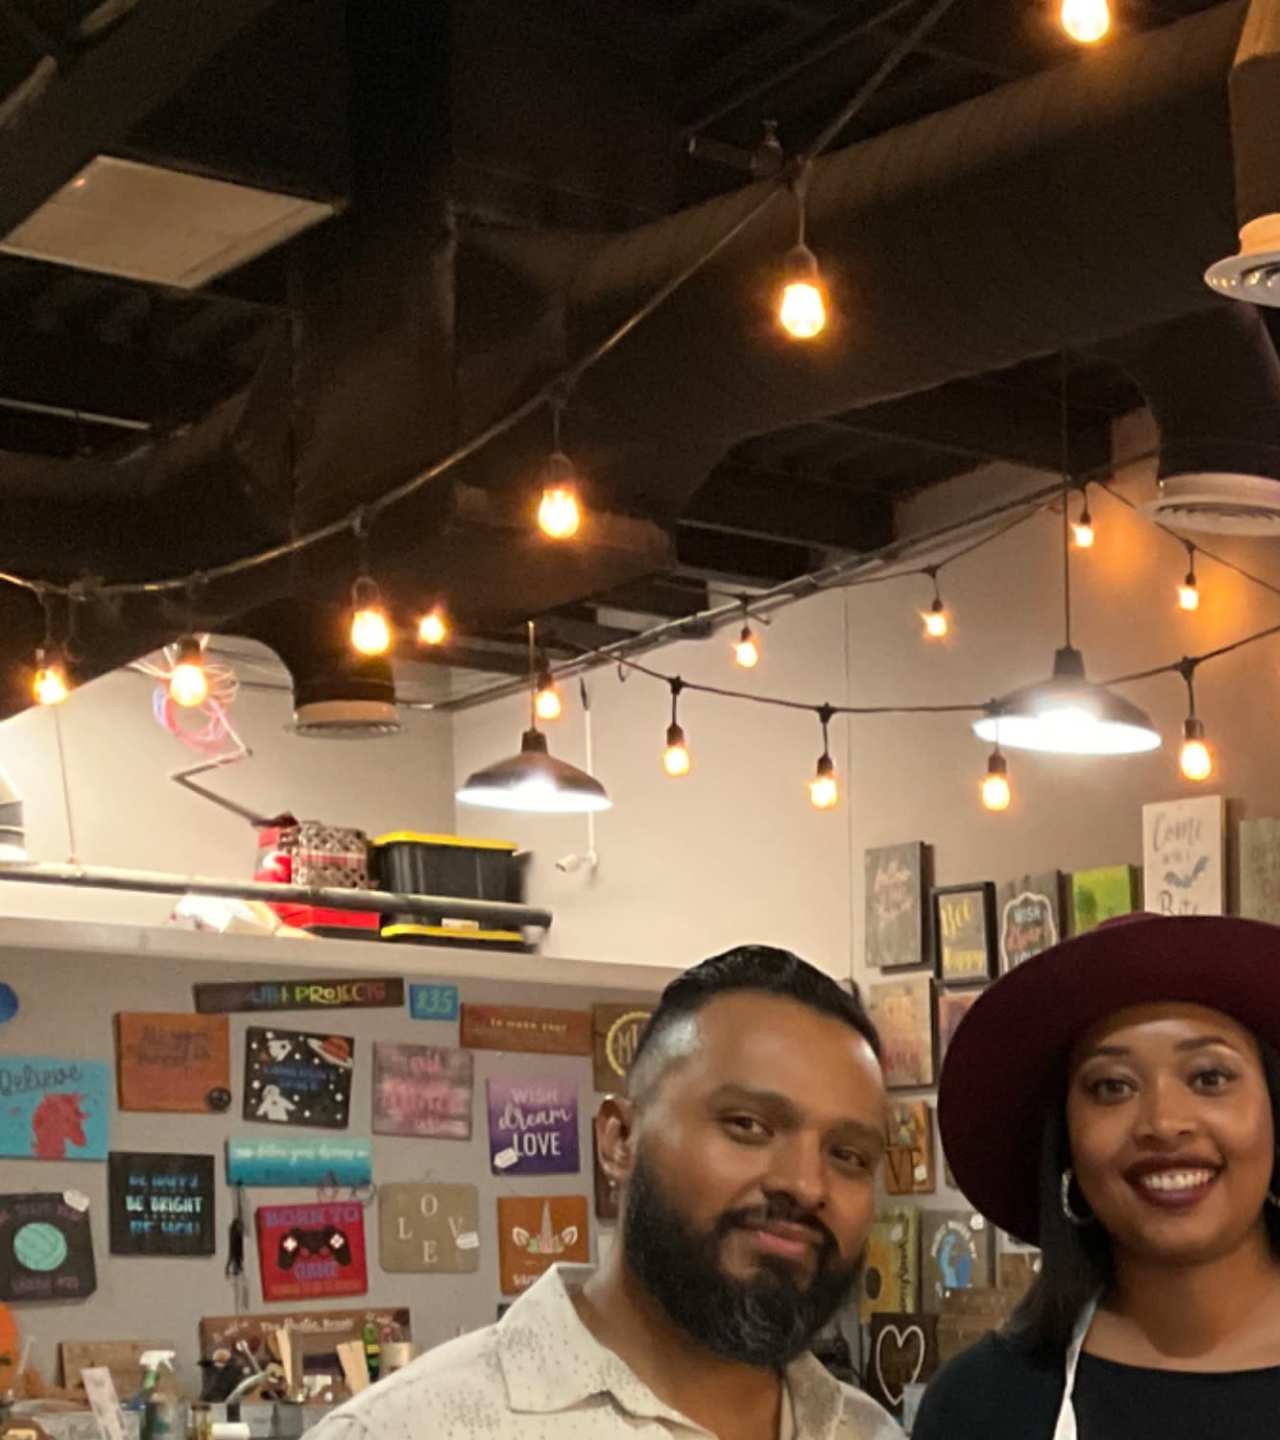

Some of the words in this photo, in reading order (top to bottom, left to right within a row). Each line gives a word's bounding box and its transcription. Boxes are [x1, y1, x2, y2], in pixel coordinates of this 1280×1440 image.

[499, 1104, 572, 1131] dream
[513, 1132, 561, 1156] LOVE
[150, 1196, 203, 1213] BRIGHT
